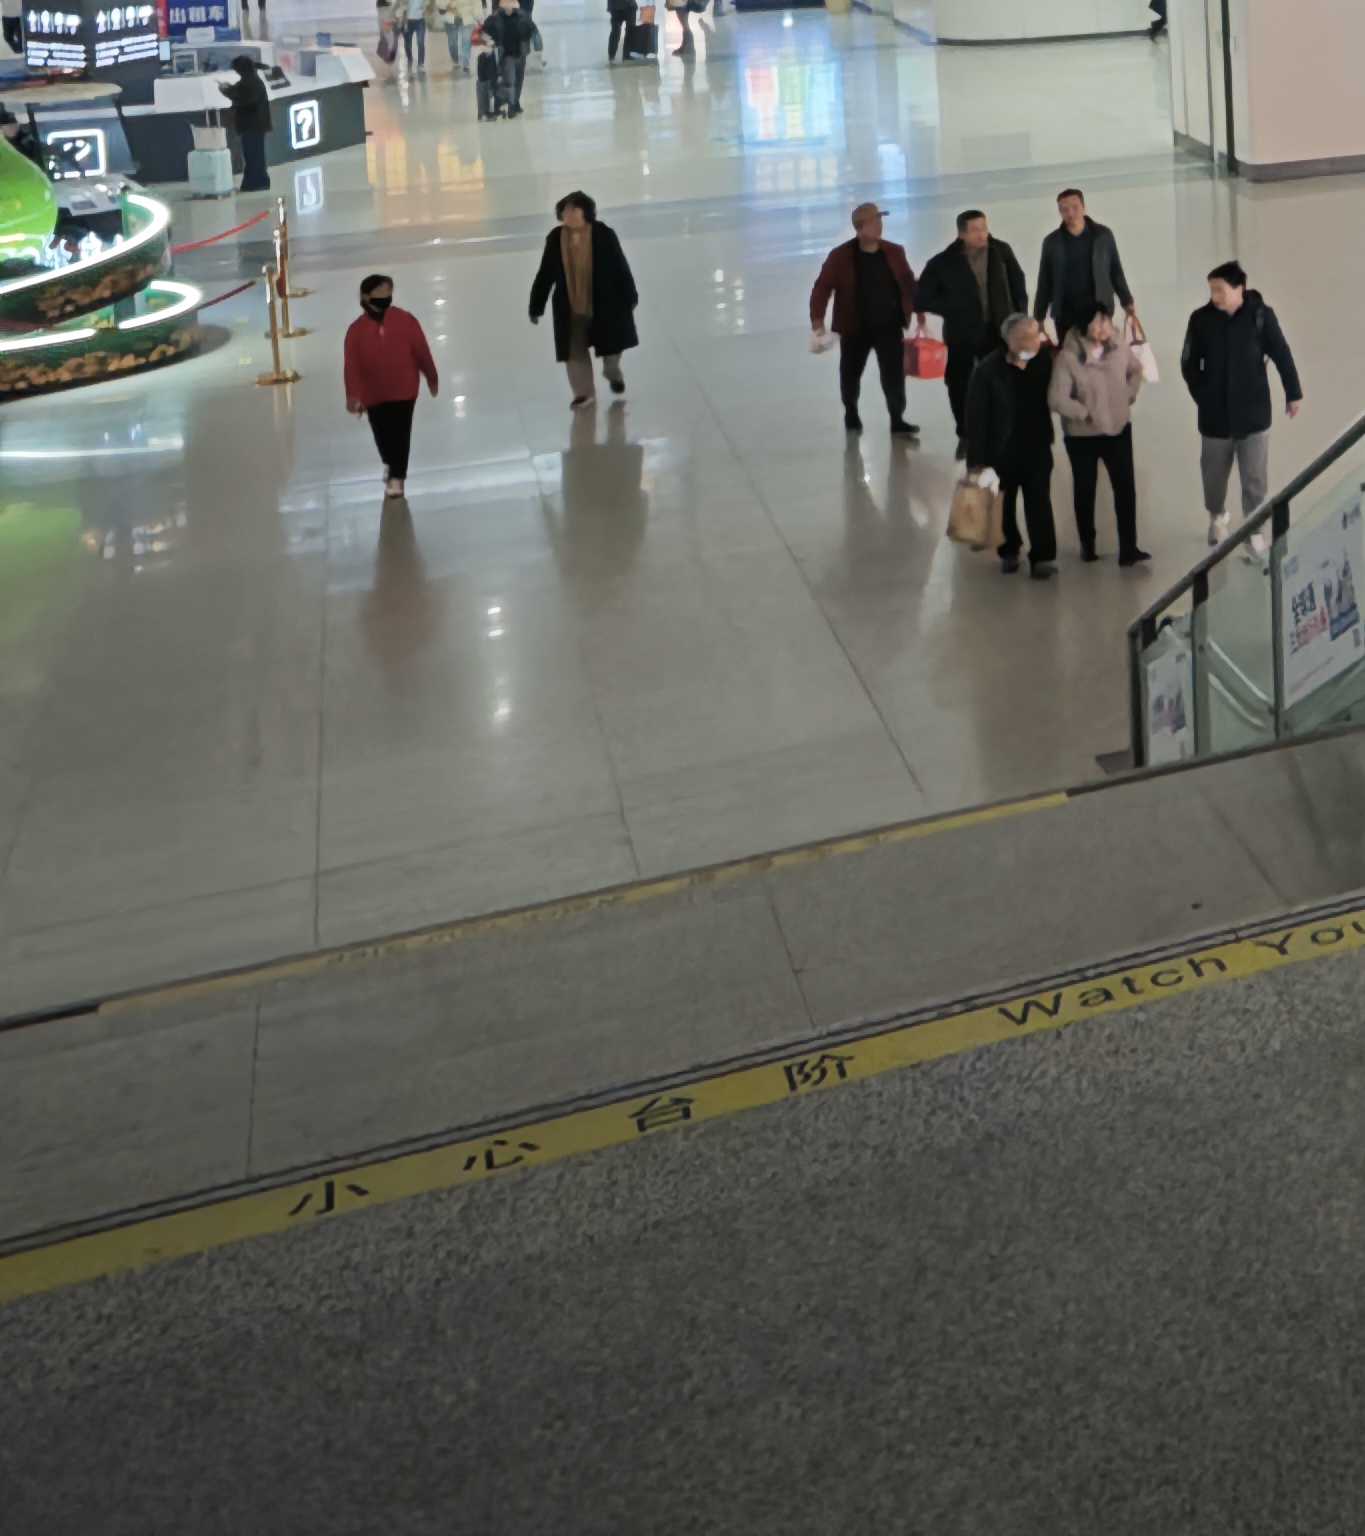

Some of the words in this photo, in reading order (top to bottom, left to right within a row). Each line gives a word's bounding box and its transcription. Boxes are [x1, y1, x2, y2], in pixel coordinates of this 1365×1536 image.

[169, 5, 225, 24] 出租车
[998, 956, 1228, 1028] Watch
[288, 1052, 855, 1215] 小心台阶
